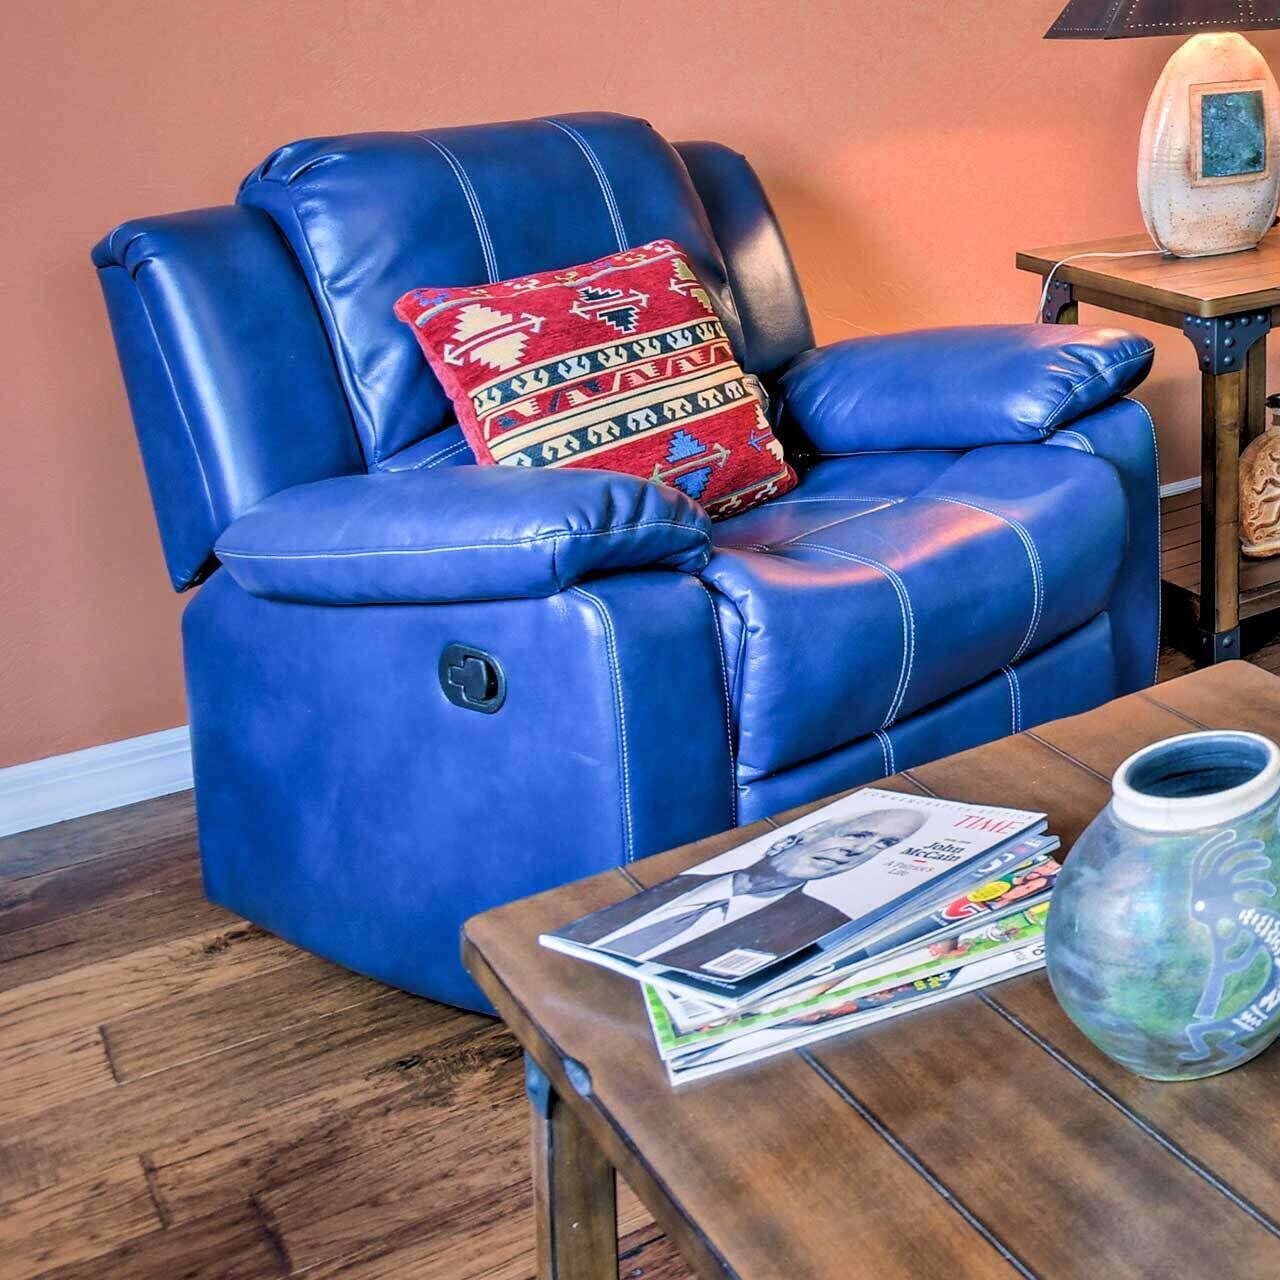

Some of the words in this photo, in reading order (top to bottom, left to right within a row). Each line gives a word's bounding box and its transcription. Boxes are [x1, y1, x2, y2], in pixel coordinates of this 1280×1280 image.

[953, 814, 1025, 835] TIME
[900, 847, 962, 862] McCain
[923, 841, 966, 854] John
